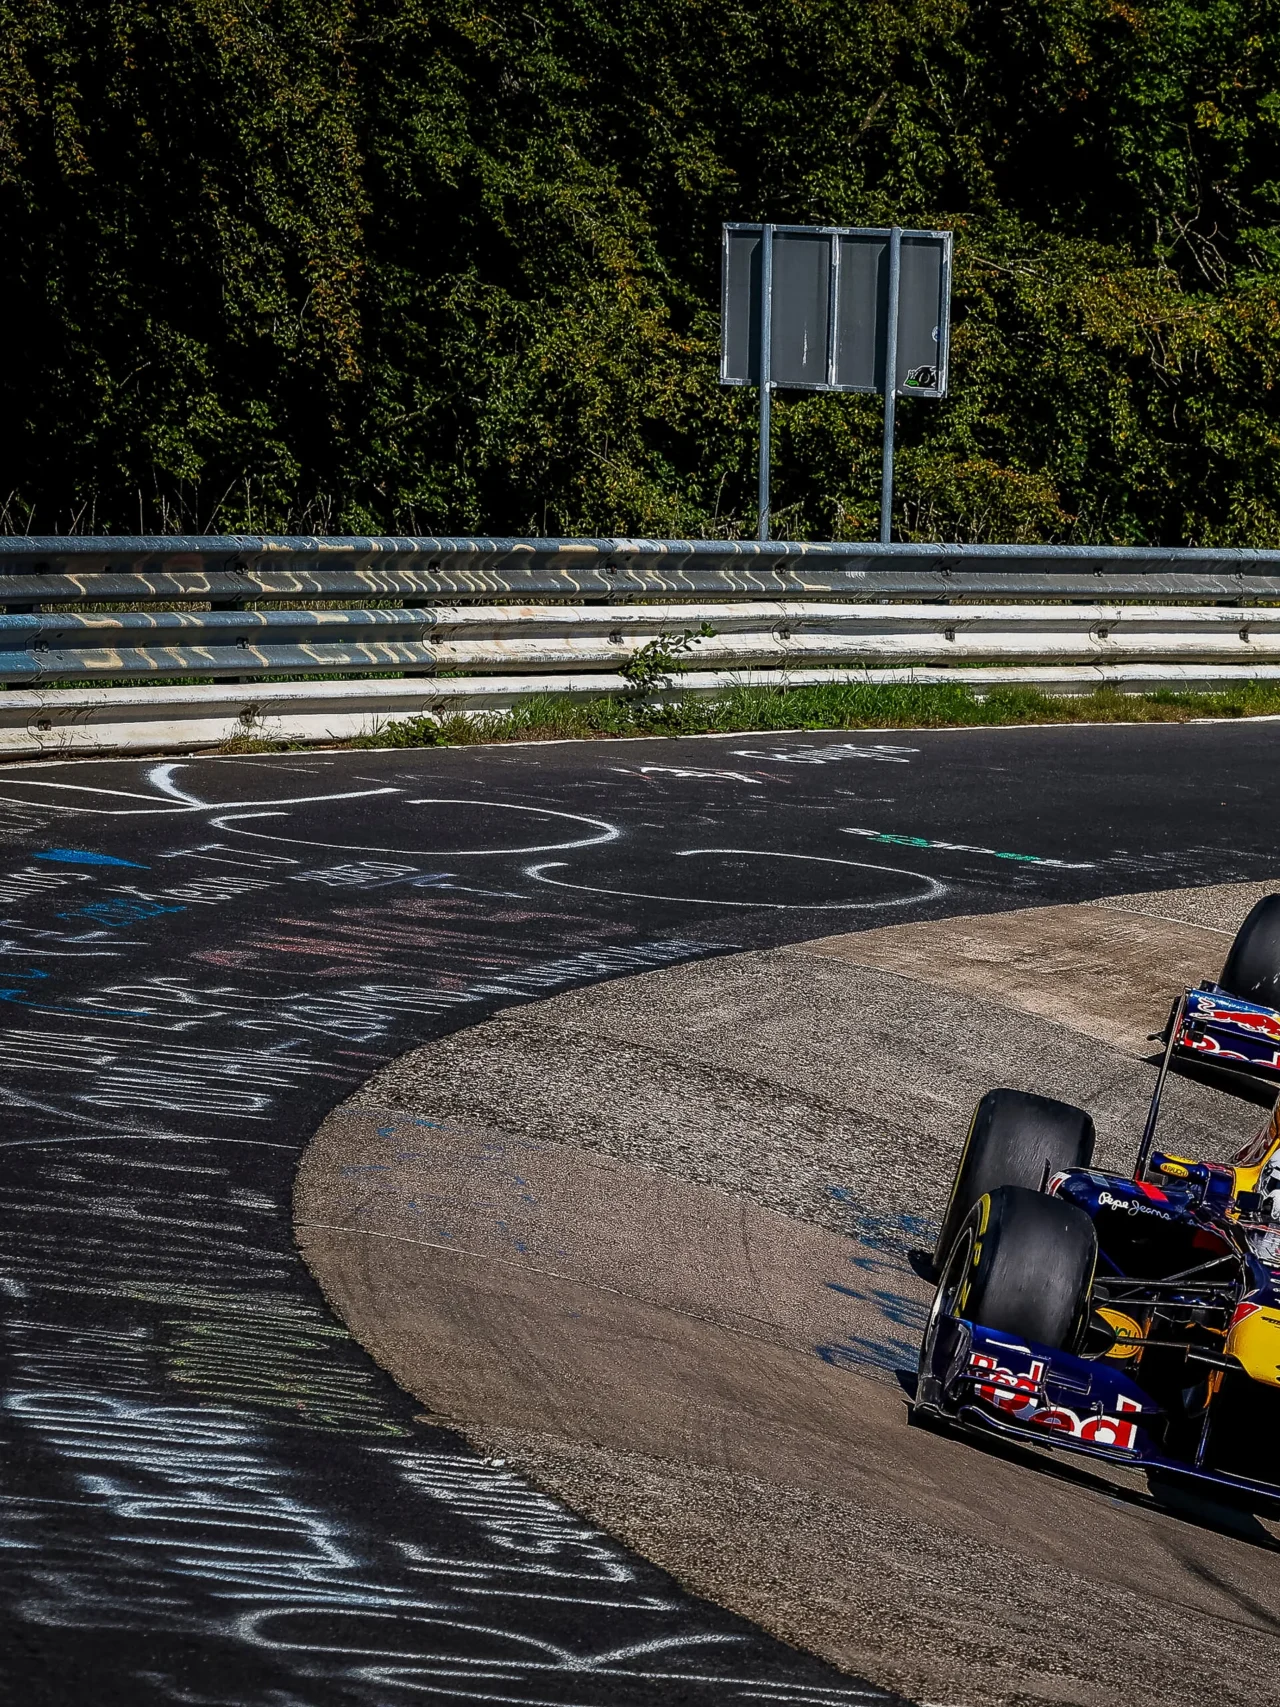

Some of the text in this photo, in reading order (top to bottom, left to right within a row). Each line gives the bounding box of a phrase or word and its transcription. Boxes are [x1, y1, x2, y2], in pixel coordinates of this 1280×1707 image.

[1164, 1164, 1189, 1177] RAUCH
[1098, 1191, 1171, 1221] Pepe Jeans
